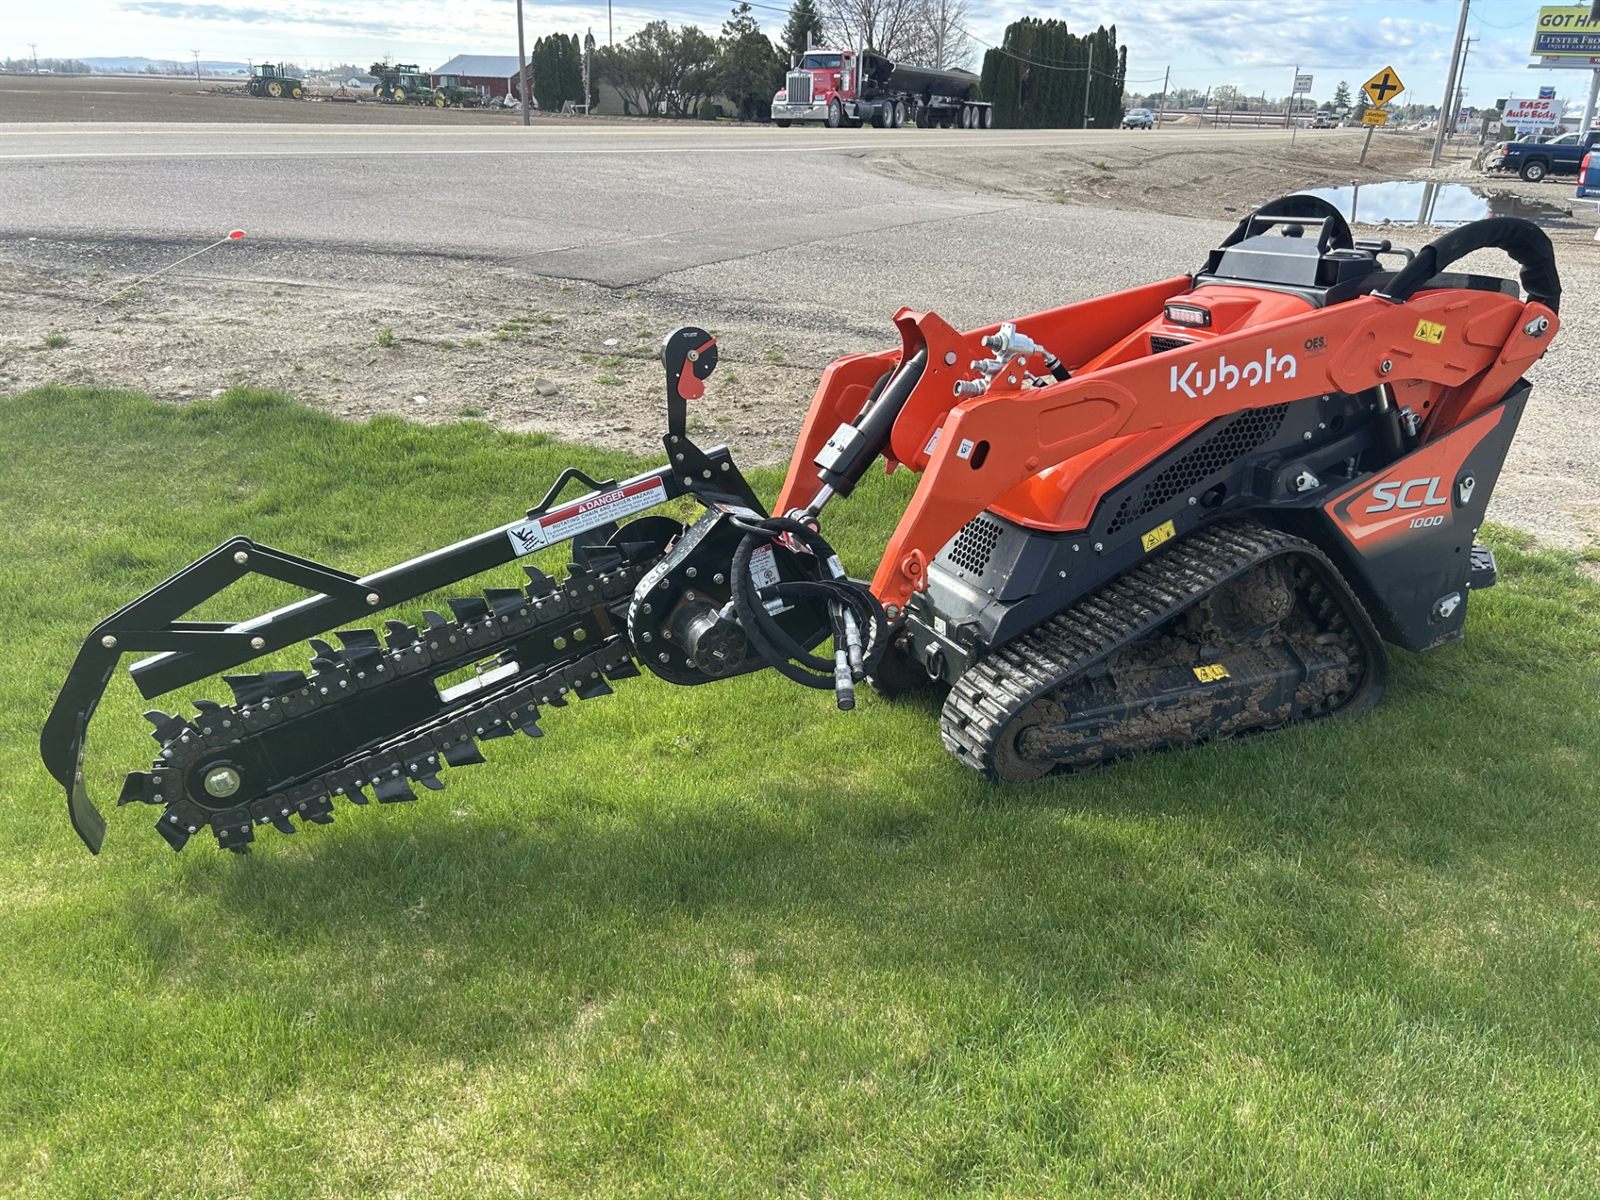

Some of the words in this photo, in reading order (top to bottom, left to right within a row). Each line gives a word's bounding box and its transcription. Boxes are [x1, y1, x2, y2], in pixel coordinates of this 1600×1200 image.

[1540, 14, 1574, 27] GOT
[1519, 101, 1549, 109] BASS
[1506, 109, 1530, 118] Auto
[1531, 110, 1556, 120] Body
[1170, 347, 1297, 399] Kubota
[586, 491, 625, 510] DANGER
[1365, 476, 1447, 514] SCL
[580, 509, 599, 519] CHAIN
[1409, 515, 1444, 529] 1000
